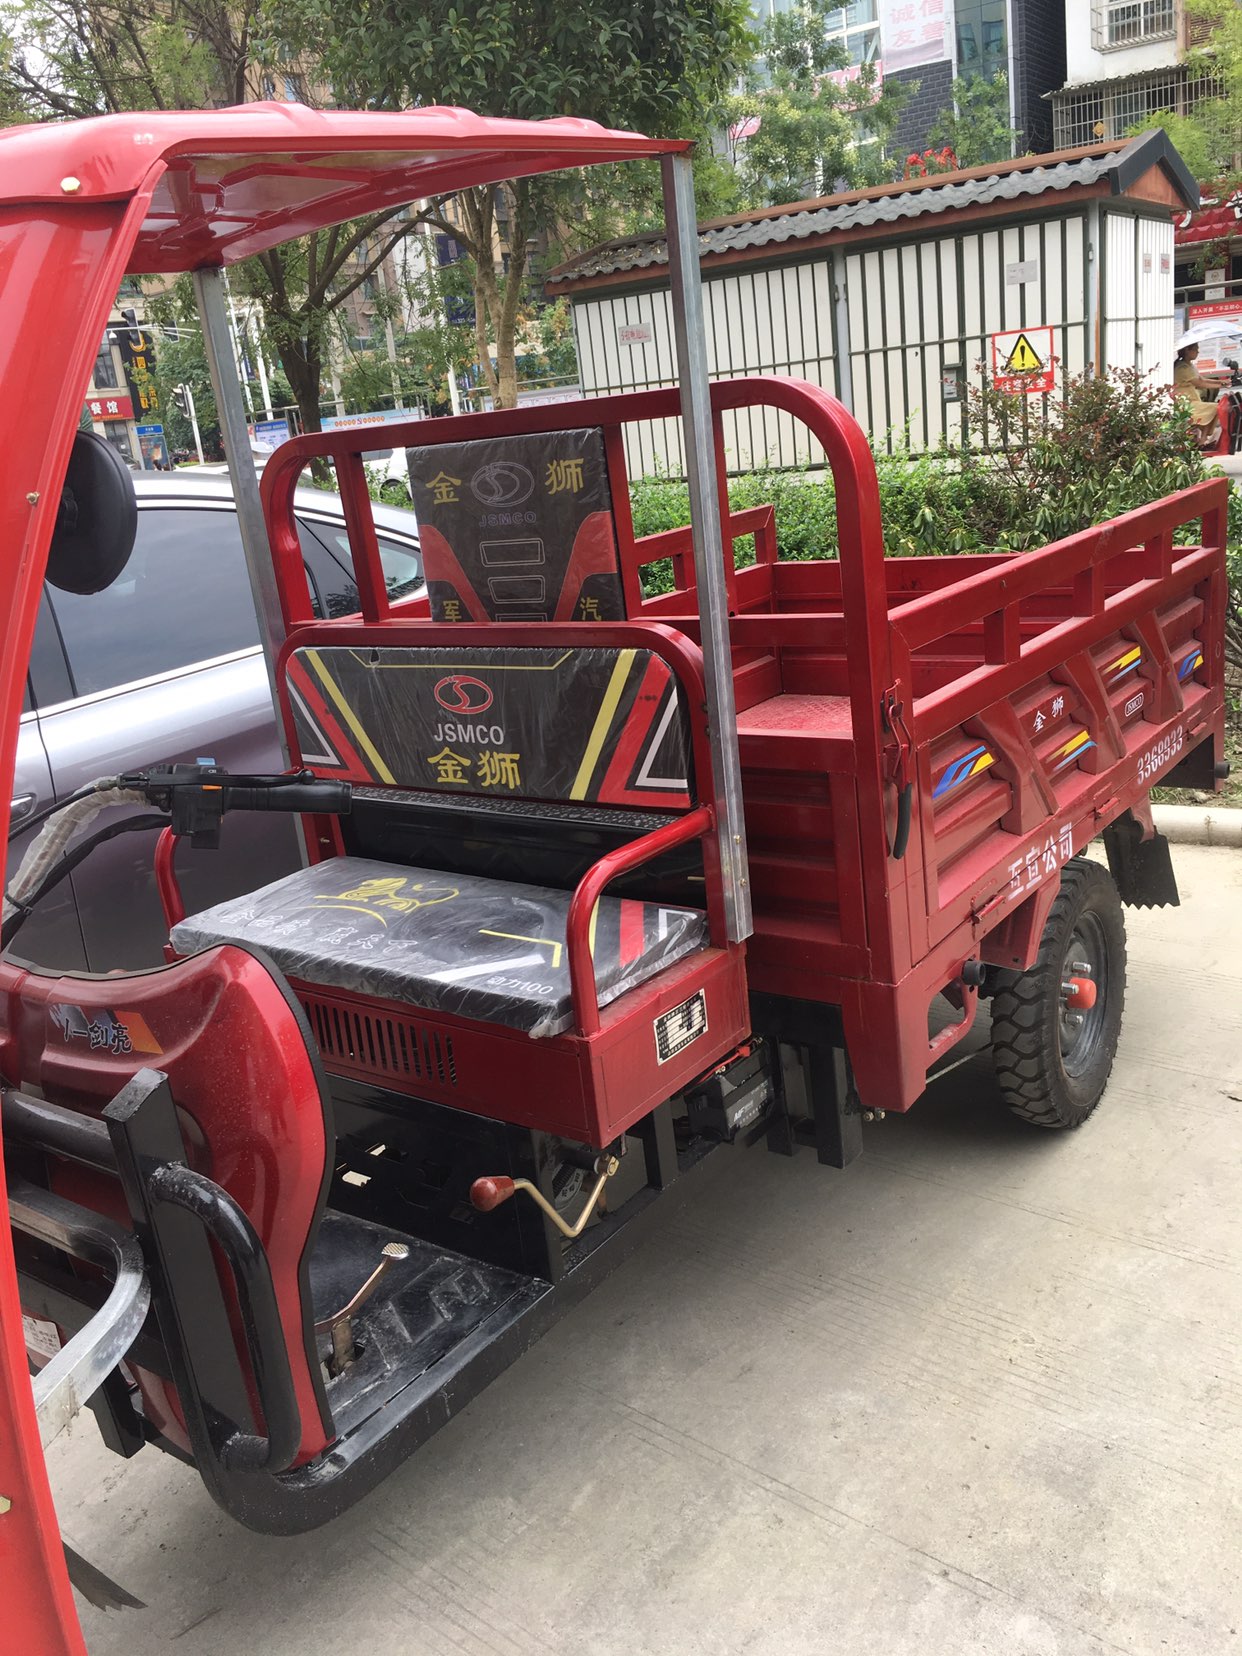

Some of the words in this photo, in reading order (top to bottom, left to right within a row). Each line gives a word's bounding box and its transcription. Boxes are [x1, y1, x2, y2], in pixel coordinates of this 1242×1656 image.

[892, 21, 945, 48] 友善
[90, 401, 118, 415] 餐馆
[425, 471, 462, 505] 金
[545, 458, 584, 495] 狮
[479, 511, 537, 527] JSMCO
[443, 599, 462, 622] 军
[580, 597, 602, 622] 汽
[433, 722, 505, 745] JSMCO
[1137, 724, 1183, 784] 3368933
[427, 747, 521, 790] 金狮
[487, 975, 554, 994] 动力100
